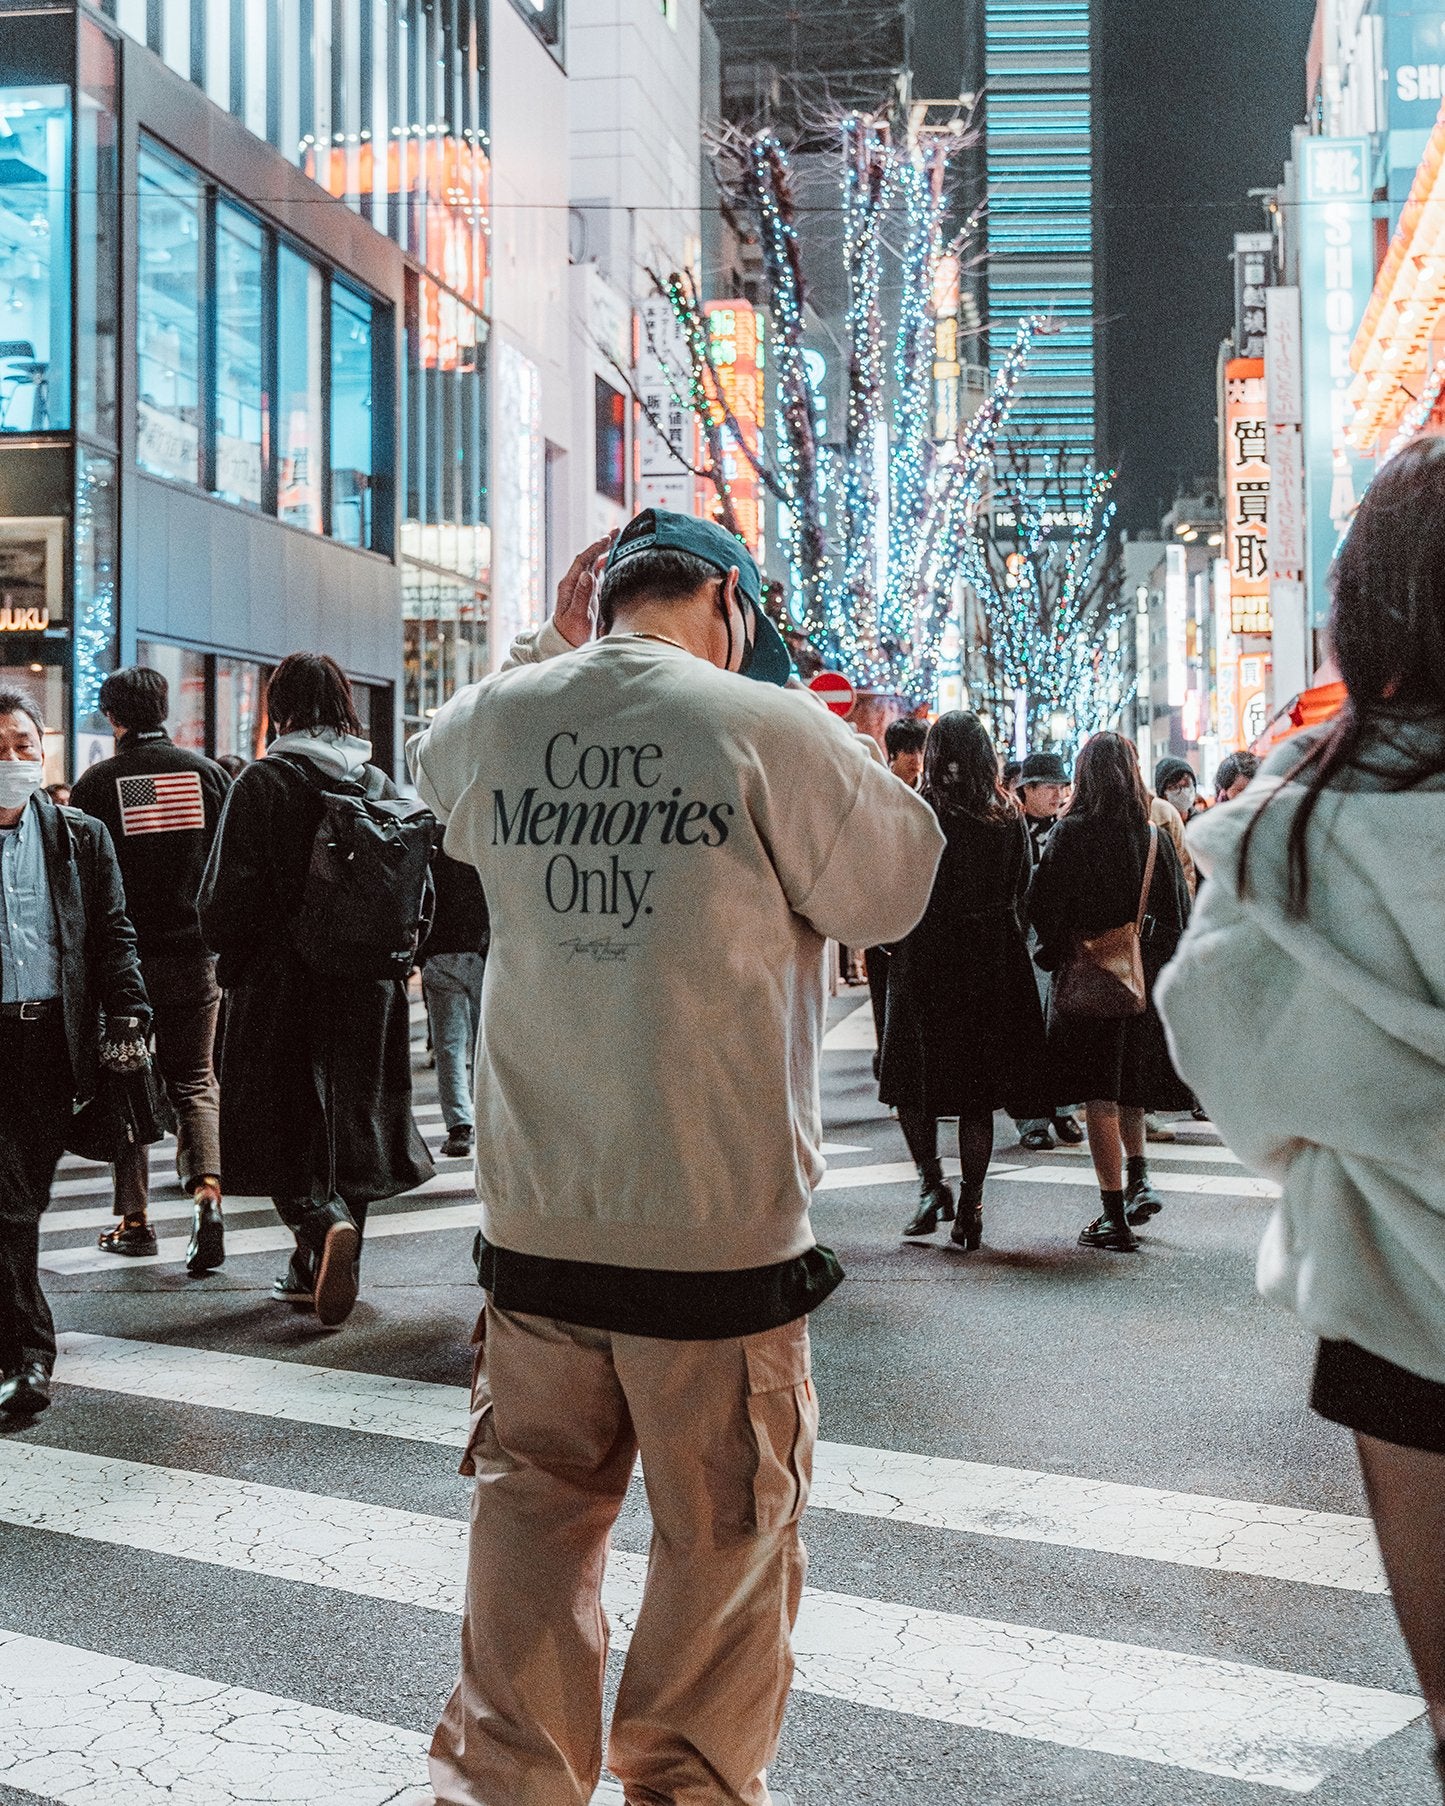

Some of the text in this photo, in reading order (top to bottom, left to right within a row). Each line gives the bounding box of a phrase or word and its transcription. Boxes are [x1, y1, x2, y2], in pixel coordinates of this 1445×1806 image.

[1396, 64, 1445, 102] SH
[545, 731, 663, 790] Core
[491, 787, 735, 848] Memories
[545, 854, 656, 929] Only.
